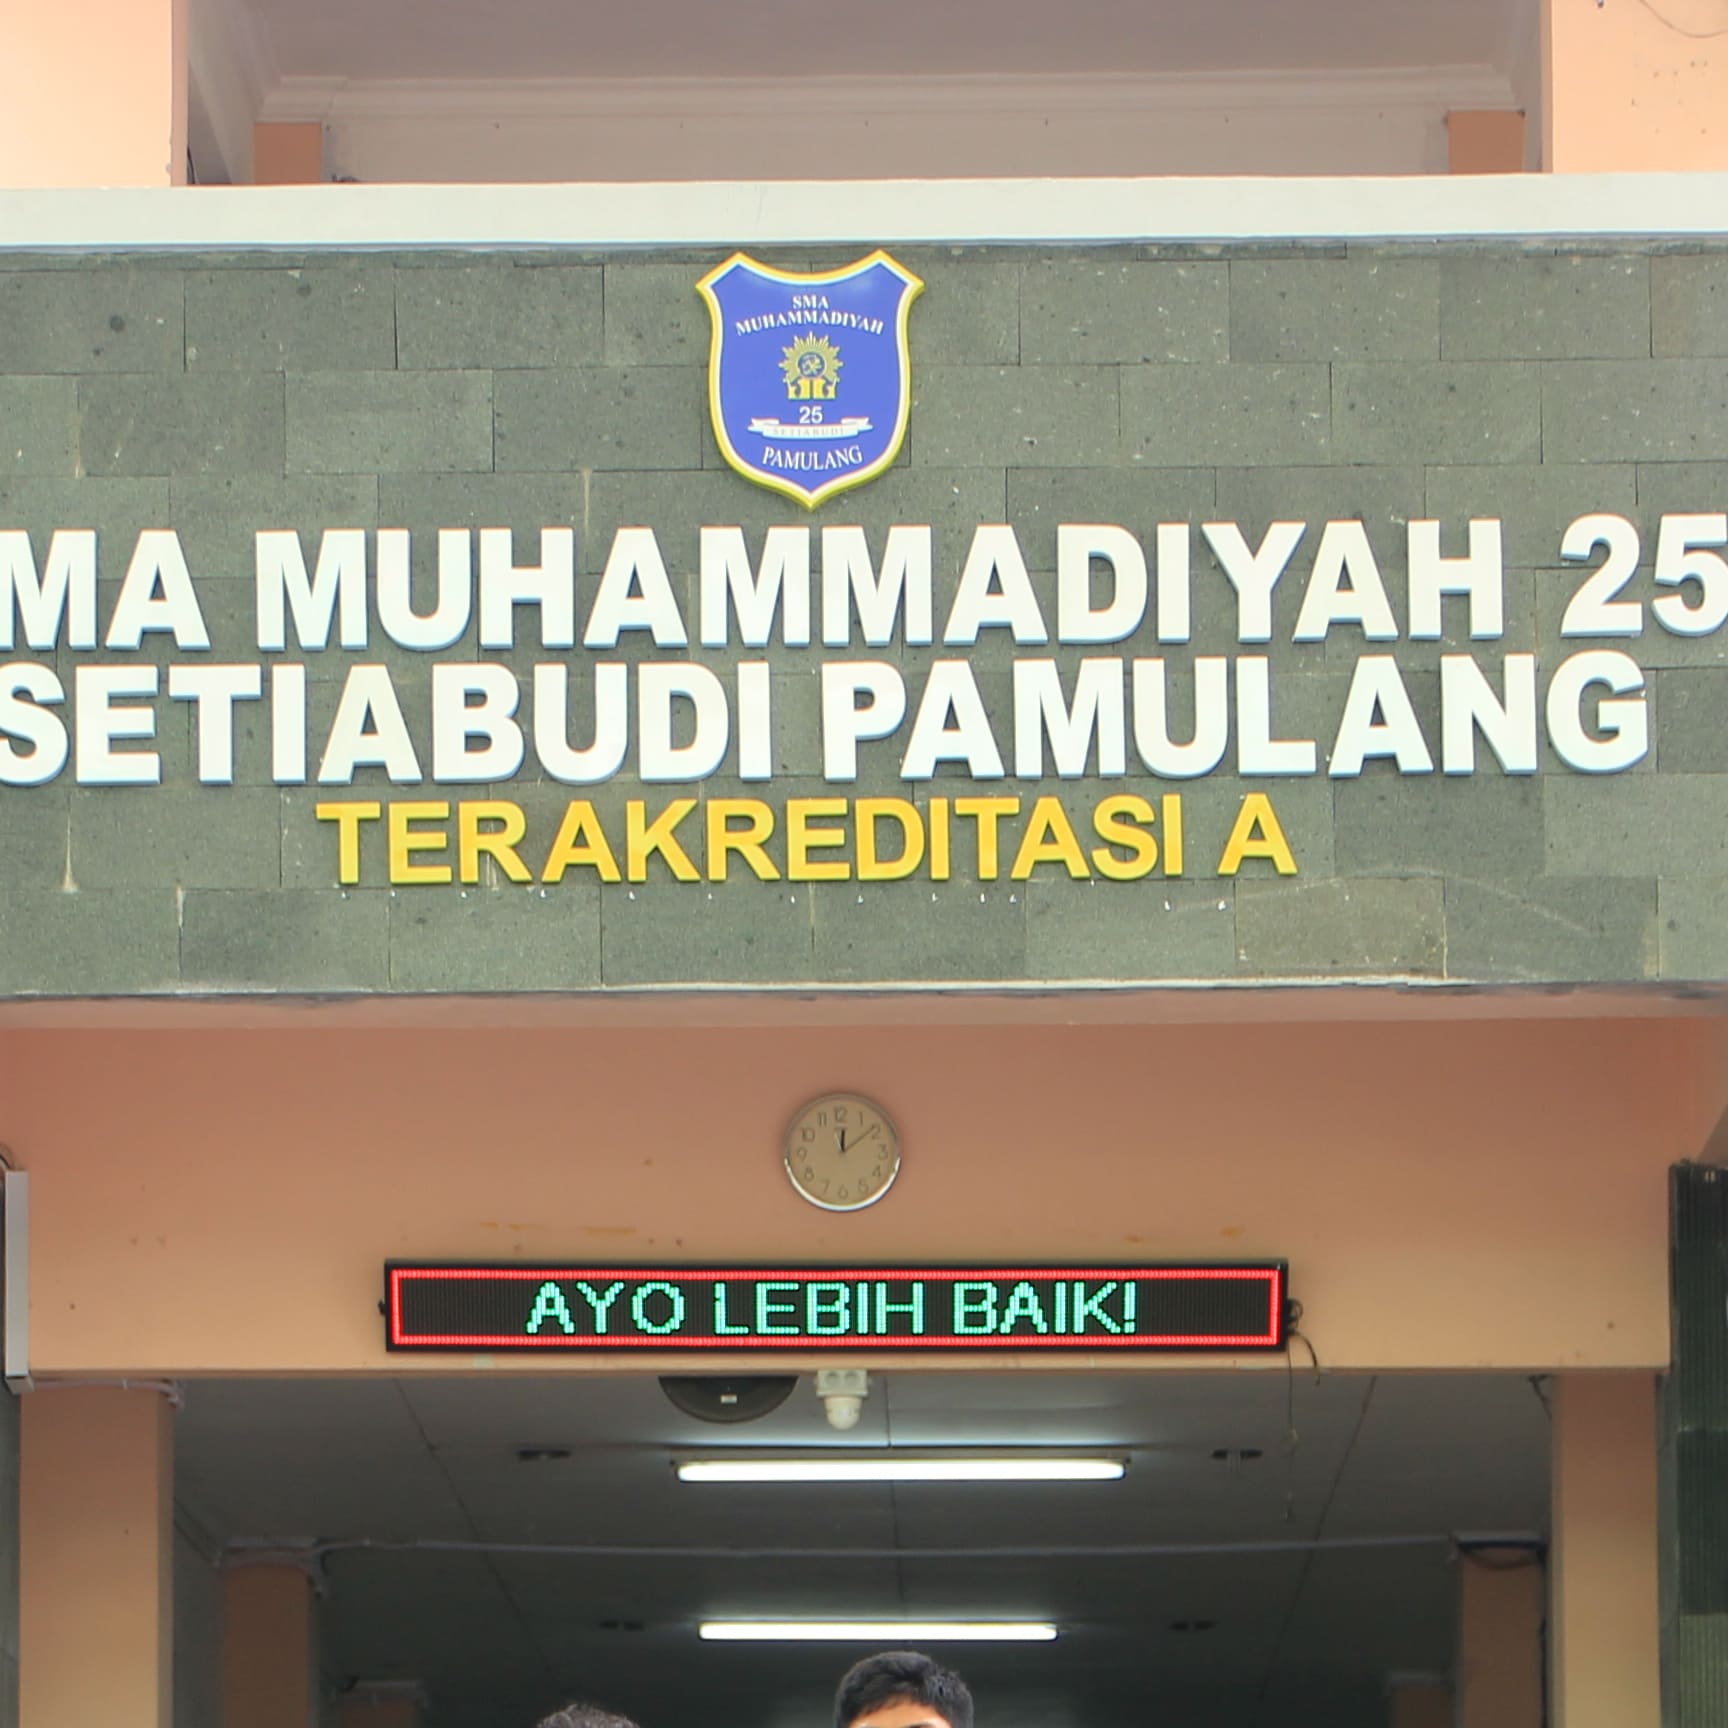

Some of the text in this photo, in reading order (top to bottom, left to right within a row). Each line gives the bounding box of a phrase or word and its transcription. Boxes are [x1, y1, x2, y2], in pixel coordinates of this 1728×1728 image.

[792, 295, 829, 309] SMA
[735, 310, 884, 336] MUHAMMADIYAH
[799, 405, 823, 424] 25
[762, 445, 863, 471] PAMULANG
[256, 519, 1505, 649] MUHAMMADIYAH
[821, 652, 1650, 780] PAMULANG
[315, 791, 1298, 884] TERAKREDITASI A
[525, 1280, 1138, 1337] AYO LEBIH BAIK!
